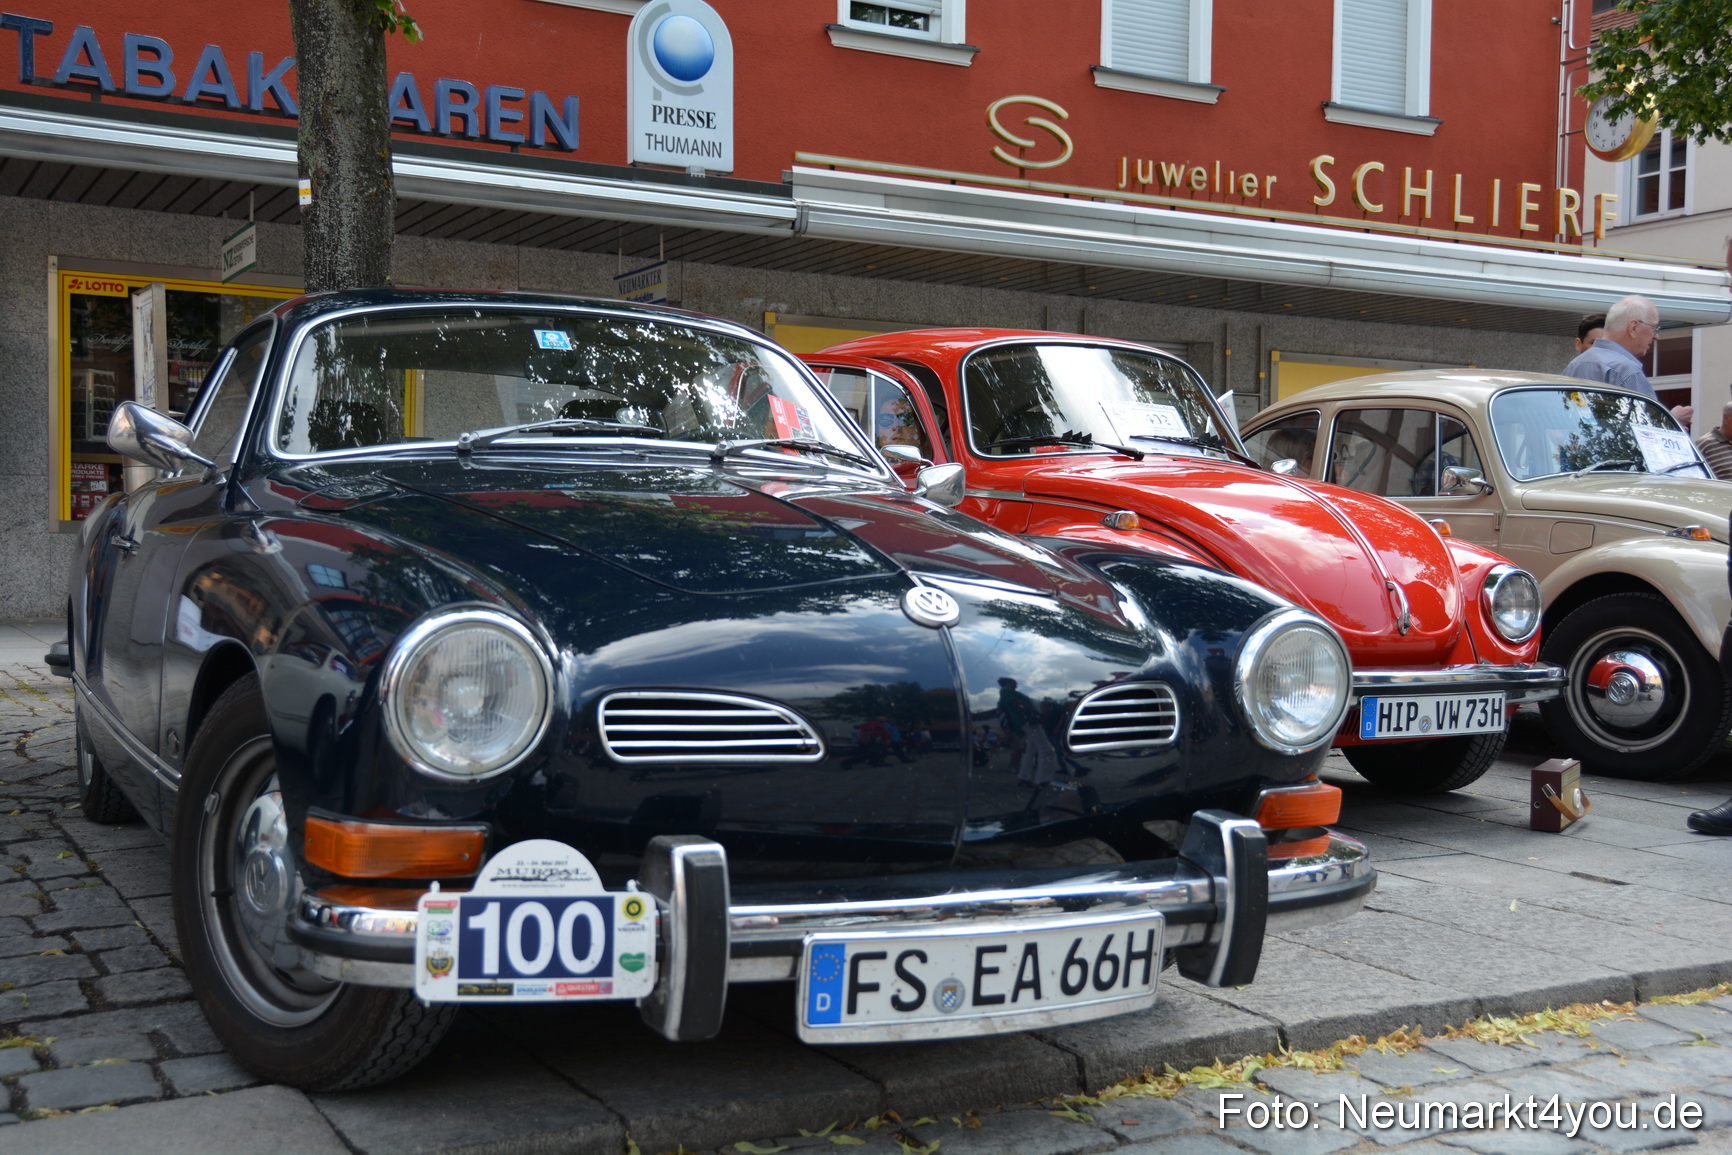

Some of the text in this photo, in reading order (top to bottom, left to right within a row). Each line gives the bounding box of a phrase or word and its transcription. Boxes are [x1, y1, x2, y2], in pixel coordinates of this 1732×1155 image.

[651, 104, 717, 131] PRESSE
[645, 132, 723, 159] THUMANN
[1308, 154, 1618, 239] SCHLIERF
[85, 280, 124, 293] LOTTO
[1662, 438, 1680, 450] 201
[1366, 721, 1371, 731] D
[1378, 698, 1502, 732] HIP VW 73H
[468, 901, 605, 975] 100
[846, 928, 1155, 1015] FS EA 66H
[815, 993, 831, 1011] D
